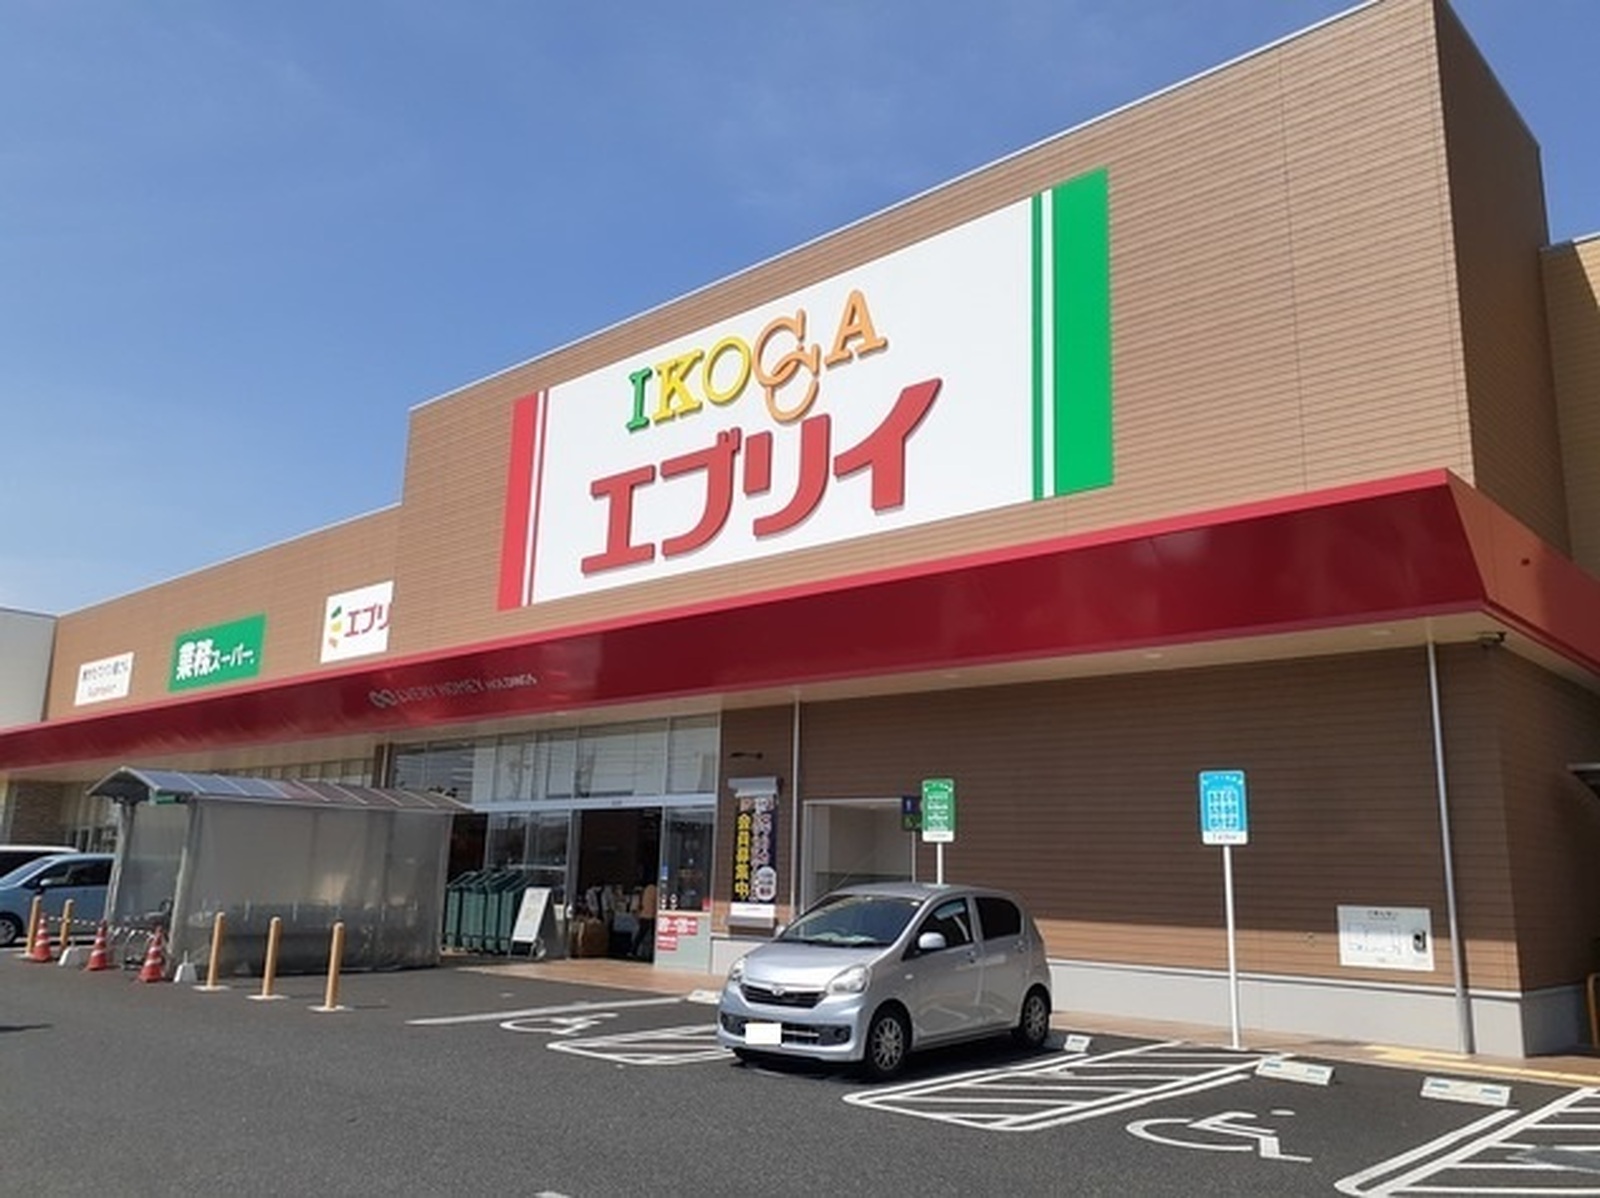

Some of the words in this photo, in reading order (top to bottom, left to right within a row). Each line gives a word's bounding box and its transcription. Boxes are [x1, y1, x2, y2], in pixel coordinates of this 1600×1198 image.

[581, 377, 943, 576] エブリイ
[176, 638, 255, 681] 業務スーパー
